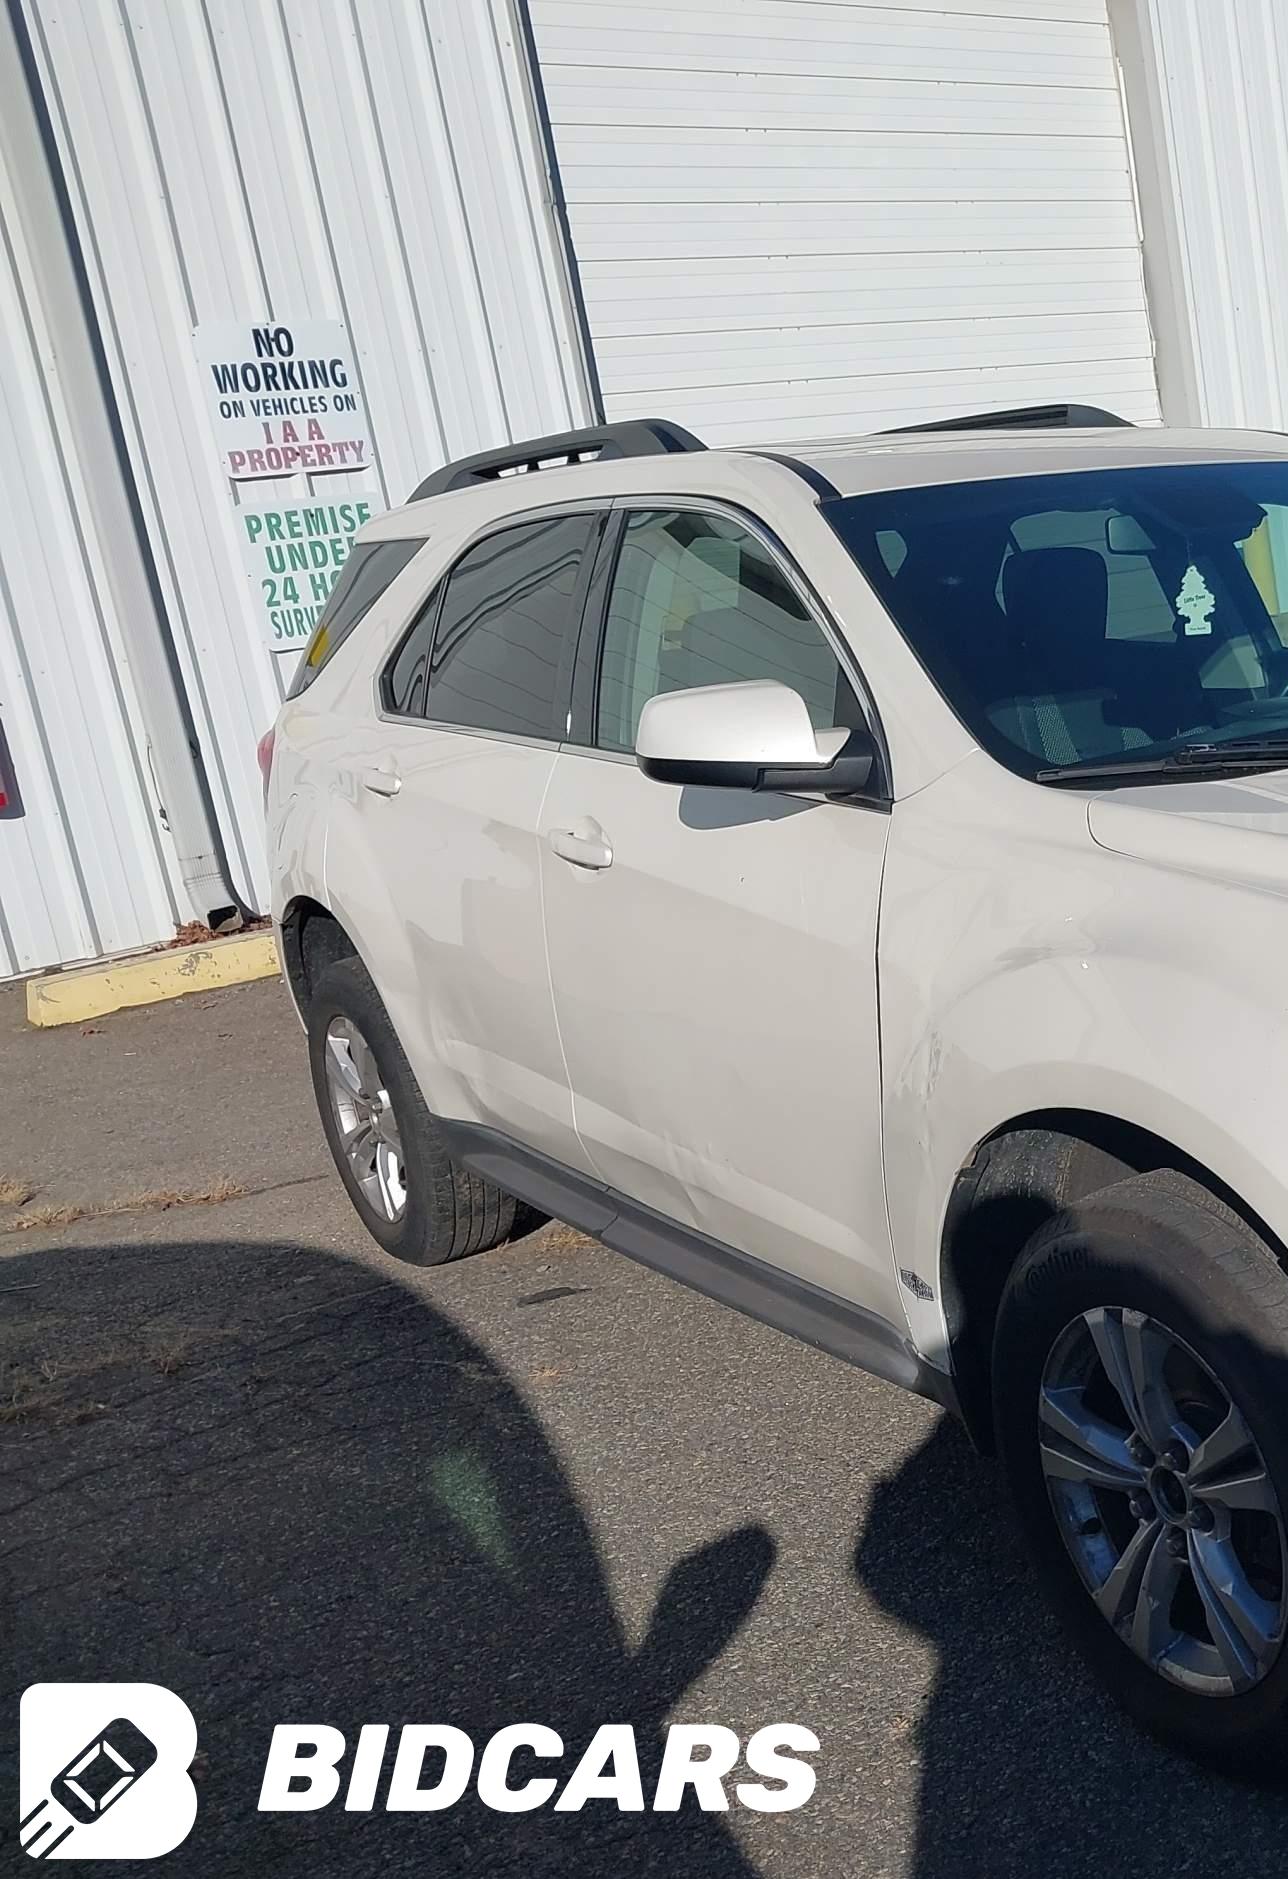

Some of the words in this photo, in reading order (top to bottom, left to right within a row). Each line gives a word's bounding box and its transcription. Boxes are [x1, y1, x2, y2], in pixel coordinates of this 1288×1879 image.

[252, 327, 294, 358] NO
[211, 359, 348, 394] WORKING
[219, 400, 246, 419] ON
[250, 395, 328, 416] VEHICLES
[333, 394, 357, 412] ON
[228, 440, 364, 473] PROPERTY
[265, 537, 355, 574] UNDE
[261, 576, 299, 608] 24
[270, 605, 324, 639] SURV
